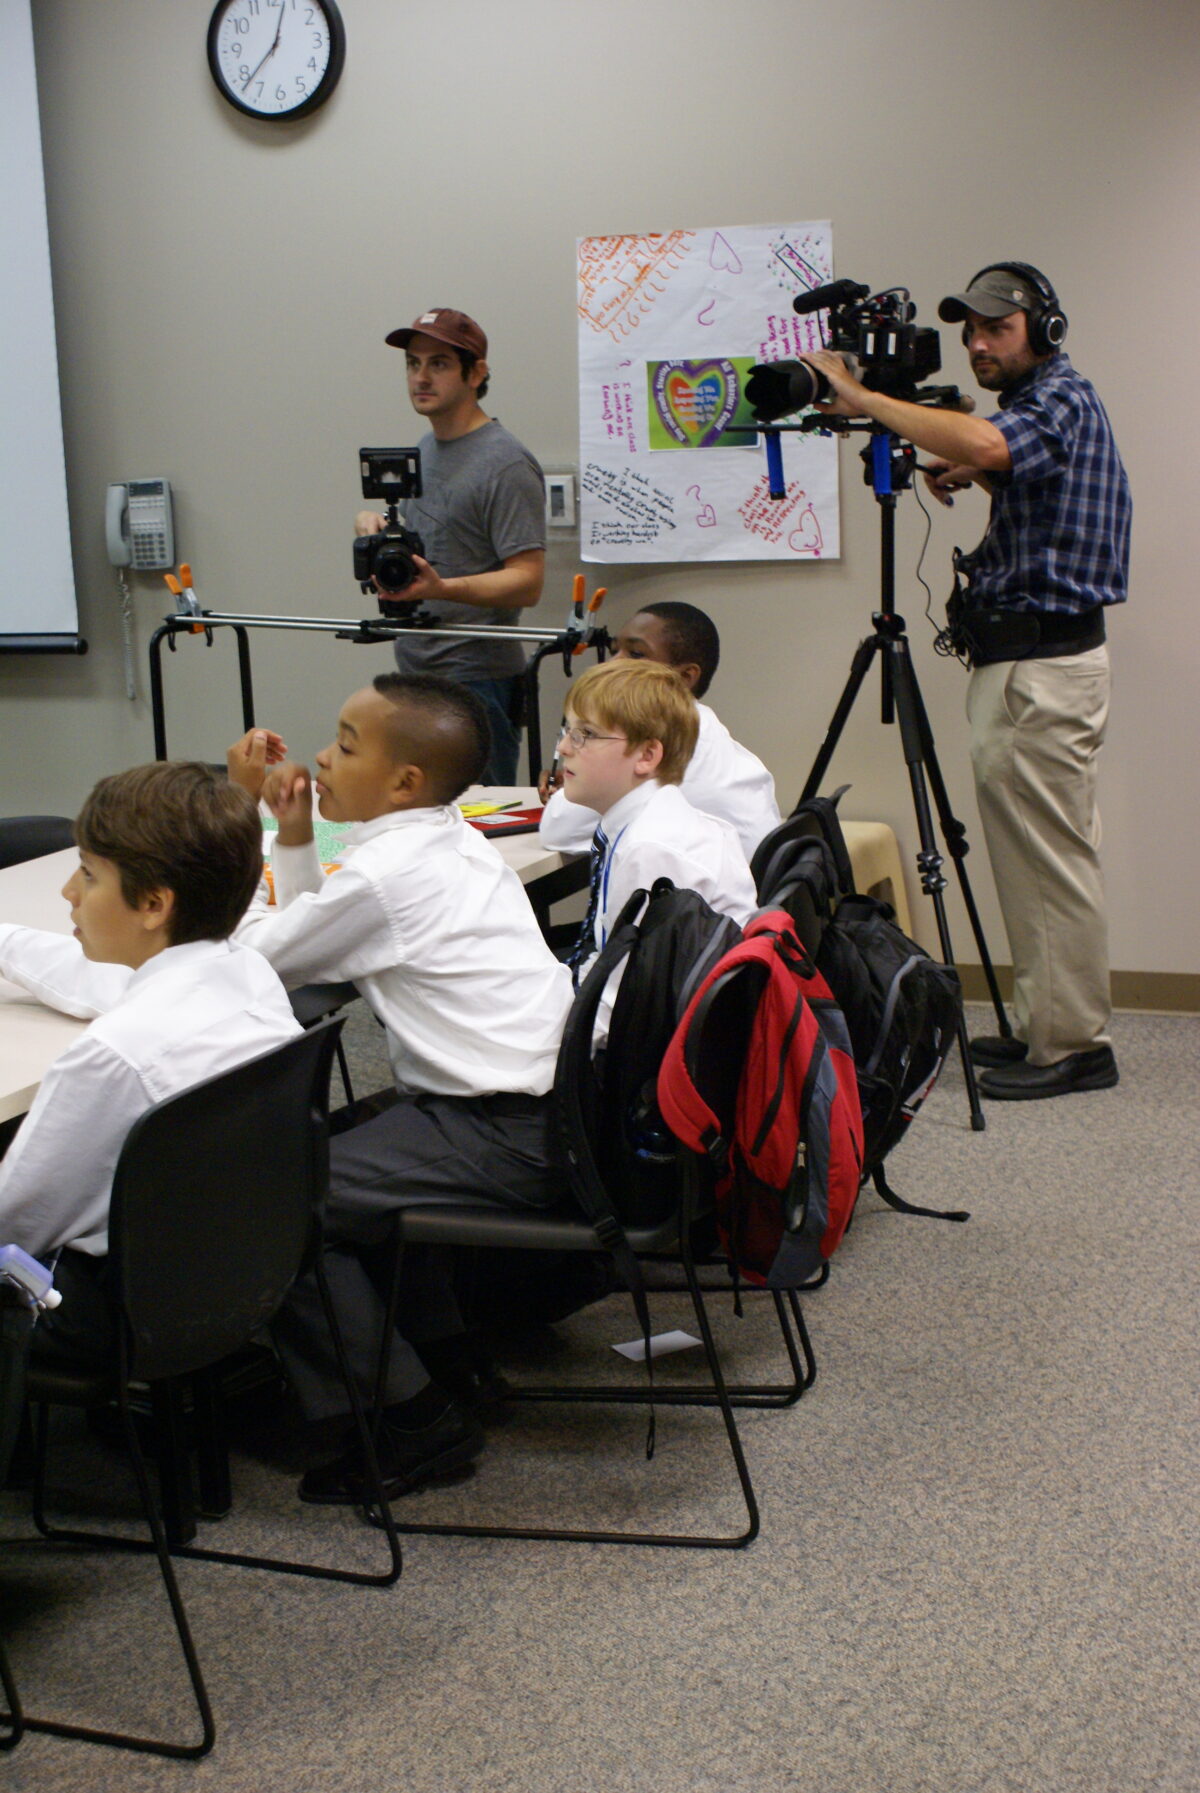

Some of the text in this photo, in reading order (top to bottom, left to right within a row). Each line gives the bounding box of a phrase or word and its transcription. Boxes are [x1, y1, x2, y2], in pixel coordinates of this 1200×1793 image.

[233, 17, 250, 34] 10
[304, 8, 315, 26] 2
[312, 32, 323, 49] 3
[231, 42, 242, 59] 9
[307, 56, 317, 73] 4
[239, 65, 250, 82] 8
[255, 81, 265, 98] 7
[275, 84, 286, 101] 6
[295, 76, 306, 94] 5
[726, 373, 737, 410] Behaviors
